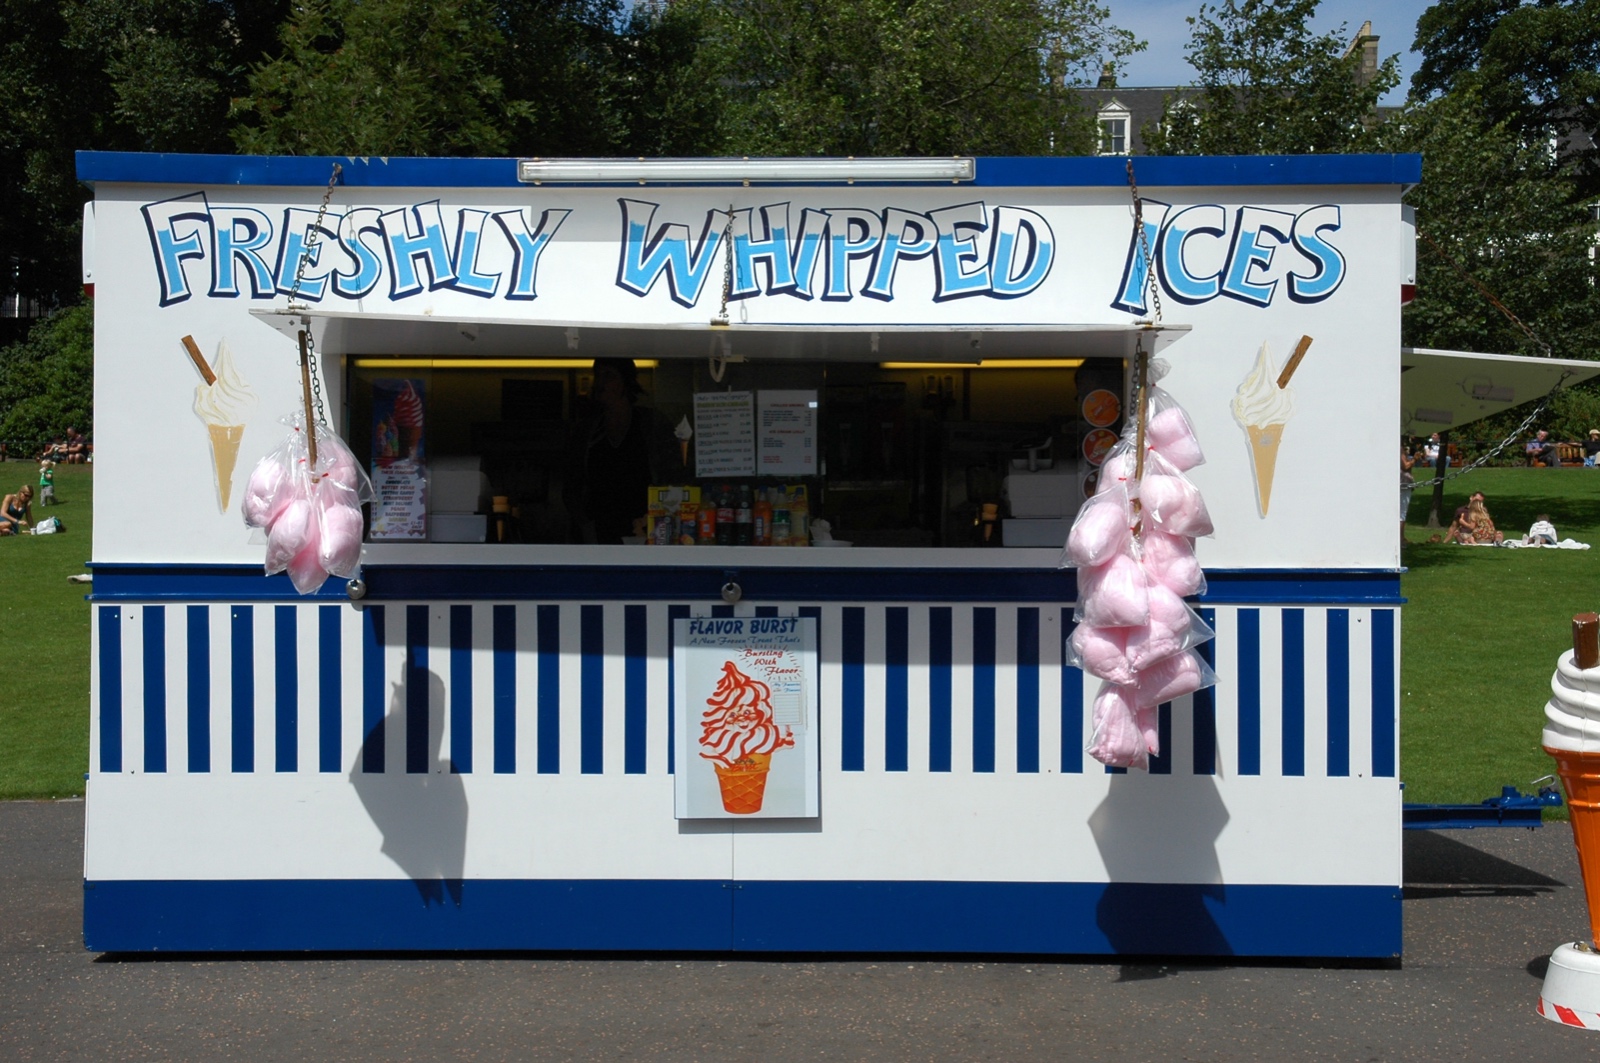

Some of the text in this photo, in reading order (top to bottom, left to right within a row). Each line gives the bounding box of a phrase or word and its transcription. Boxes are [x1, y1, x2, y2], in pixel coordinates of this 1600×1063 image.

[141, 191, 1347, 316] FRESHLY WHIPPED ICES
[690, 619, 798, 635] FLAVOR BURST
[743, 648, 784, 658] Bursting
[765, 666, 799, 675] Flavor
